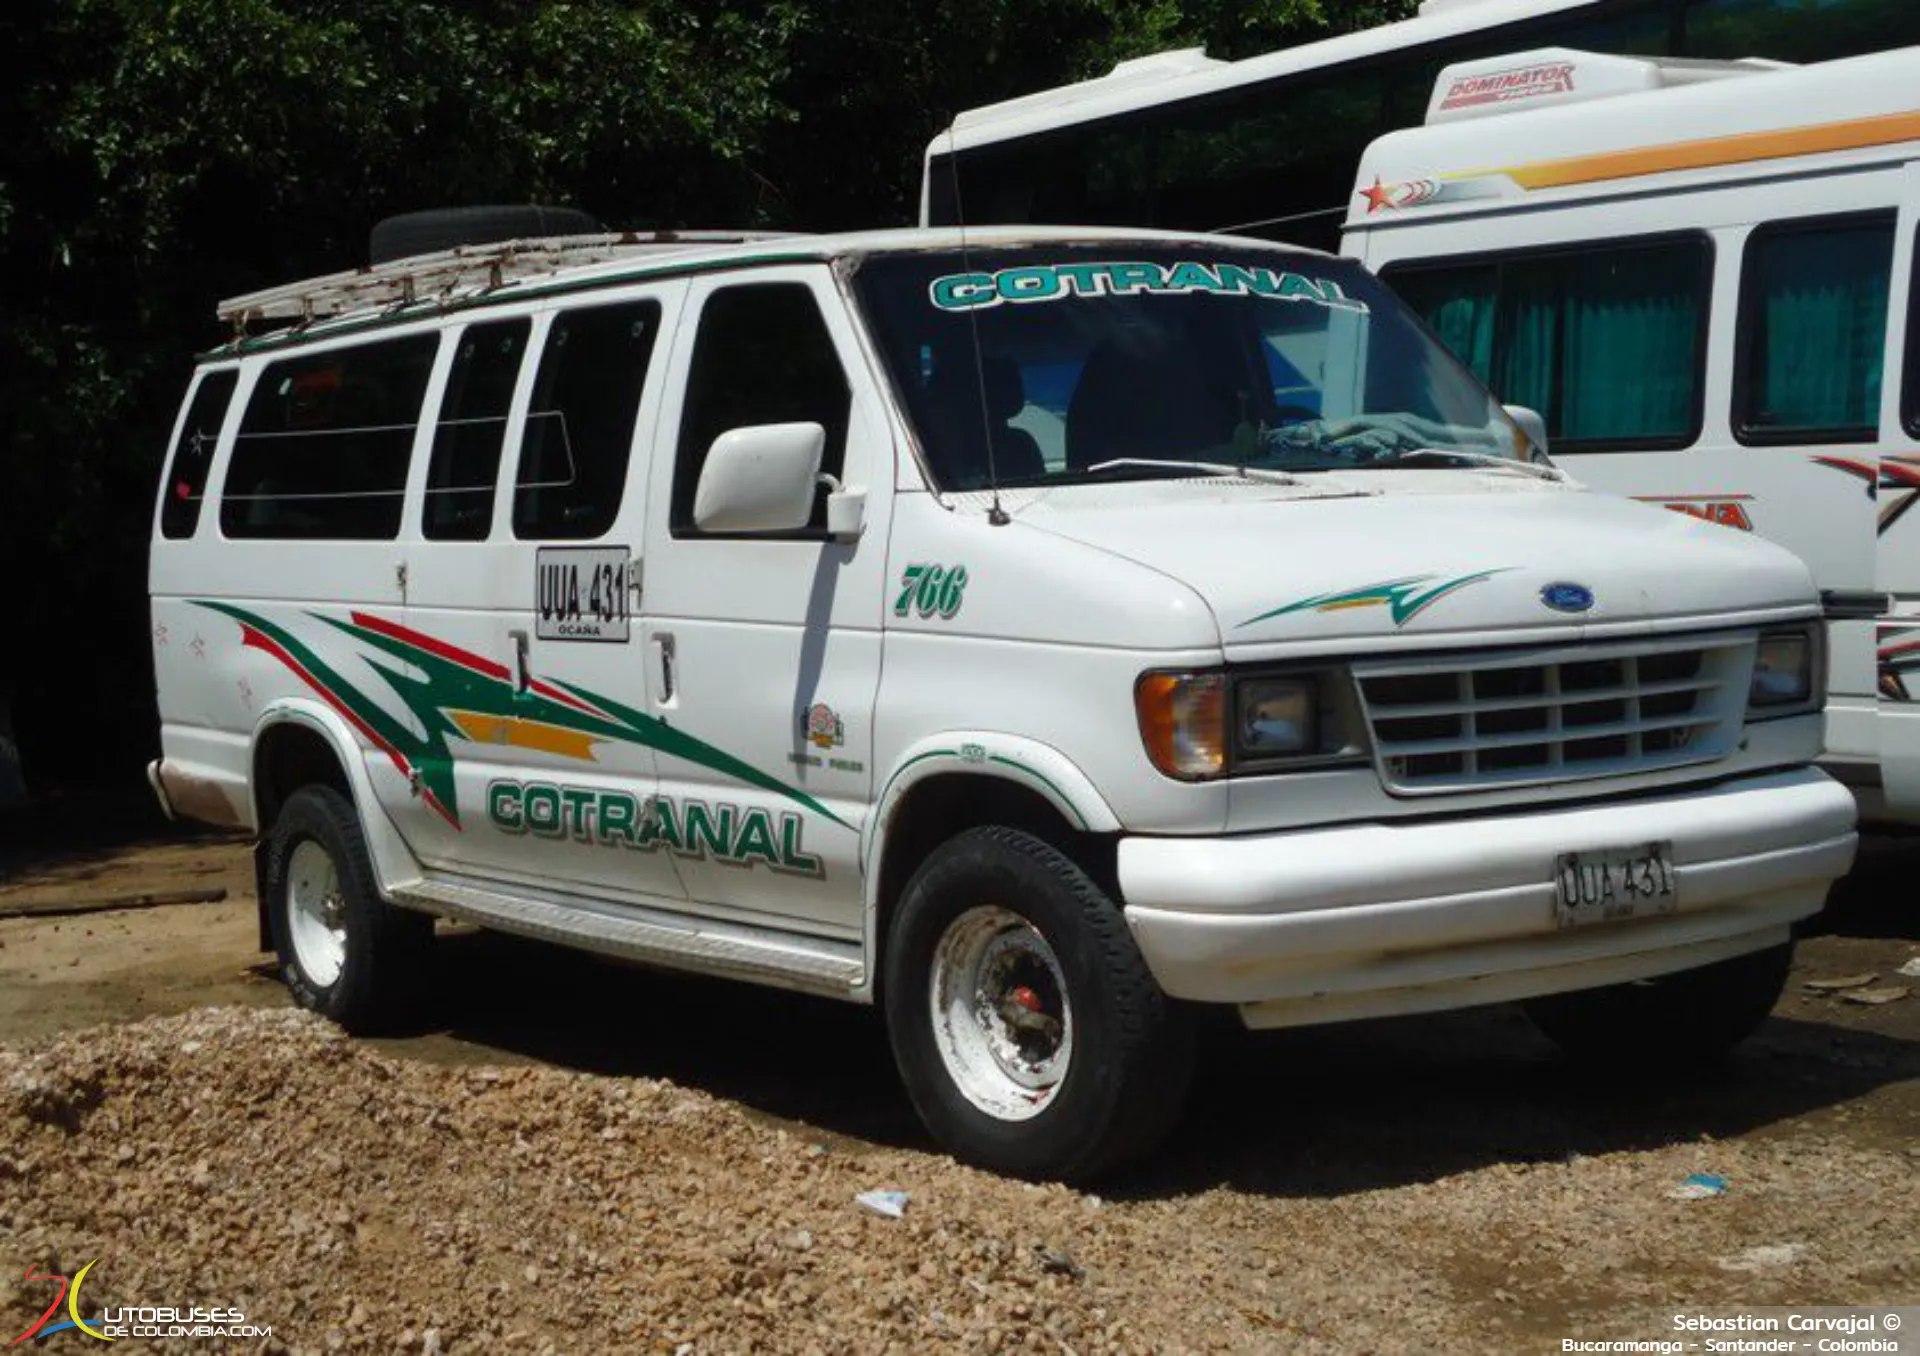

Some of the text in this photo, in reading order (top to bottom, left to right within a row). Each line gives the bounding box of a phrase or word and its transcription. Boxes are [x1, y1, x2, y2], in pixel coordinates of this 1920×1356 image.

[1447, 64, 1576, 97] DOMINATOR
[929, 261, 1369, 313] COTRANAL
[540, 564, 625, 624] UUA 431
[894, 563, 969, 620] 766
[487, 778, 827, 880] COTRANAL
[1561, 855, 1672, 908] UUA 431
